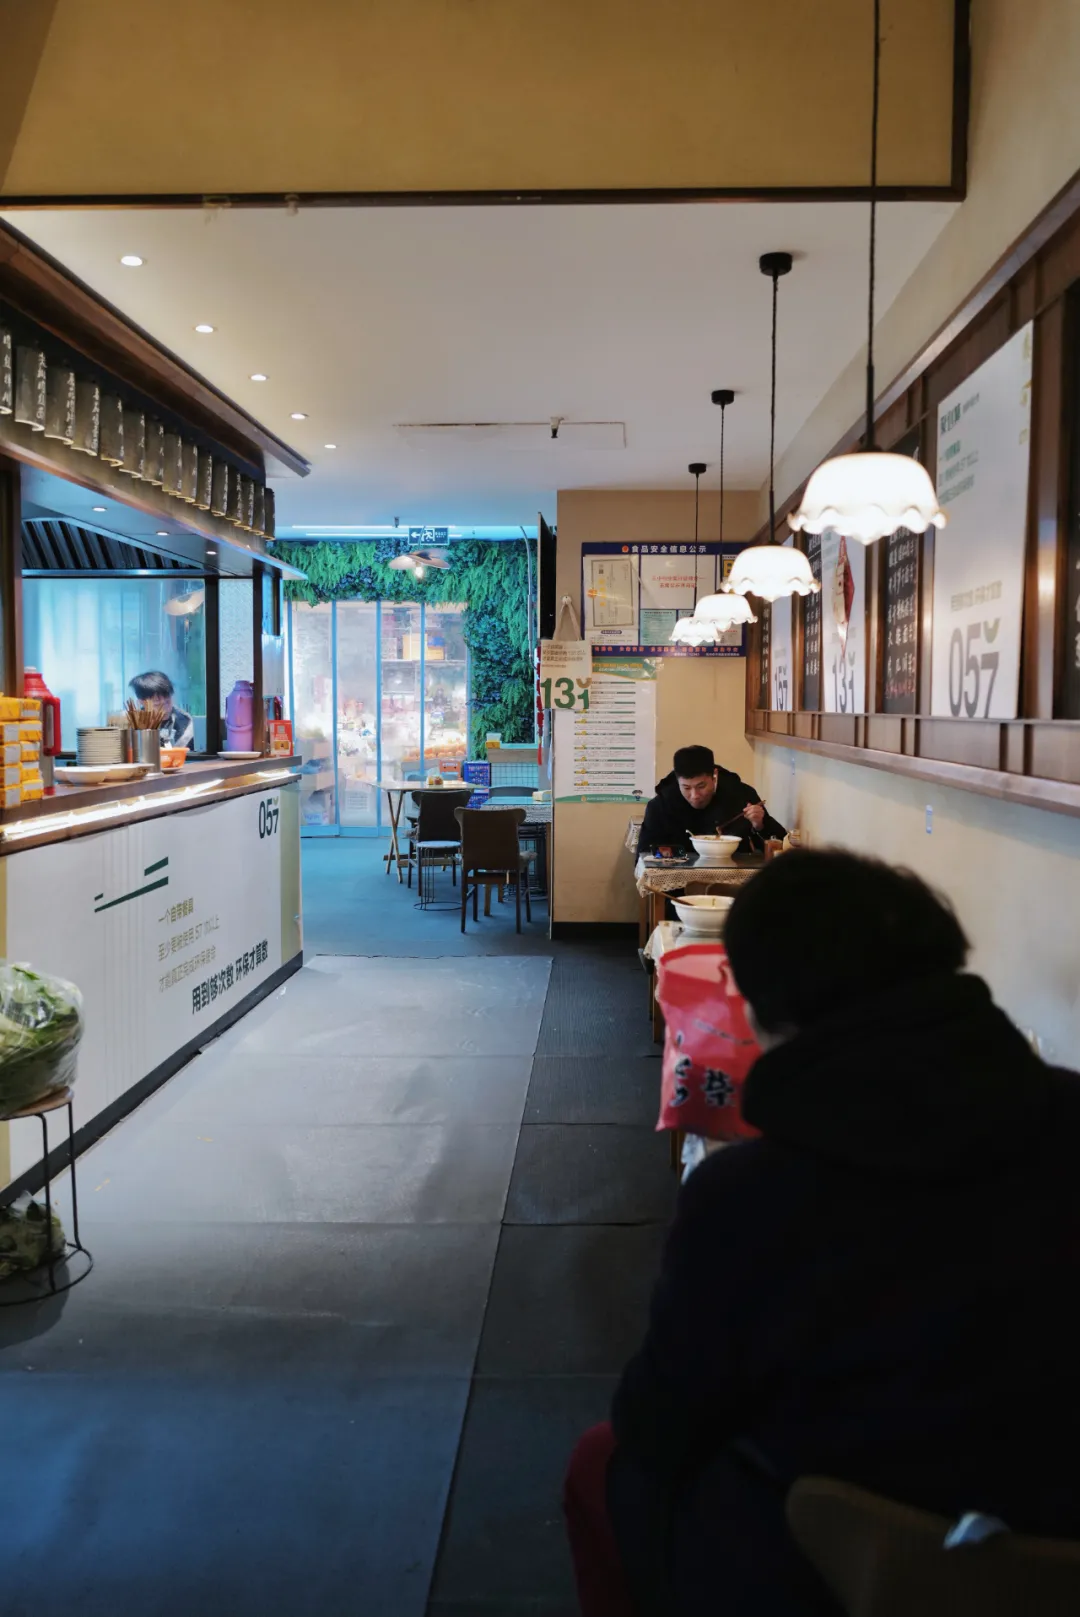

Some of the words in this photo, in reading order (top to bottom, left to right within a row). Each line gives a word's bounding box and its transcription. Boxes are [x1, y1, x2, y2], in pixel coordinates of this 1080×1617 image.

[631, 545, 707, 553] 食品安全信息公示
[949, 618, 1000, 718] 057
[540, 677, 591, 709] 131
[258, 796, 280, 839] 057
[192, 963, 234, 1015] 用到够次数
[235, 939, 269, 982] 环保才算数
